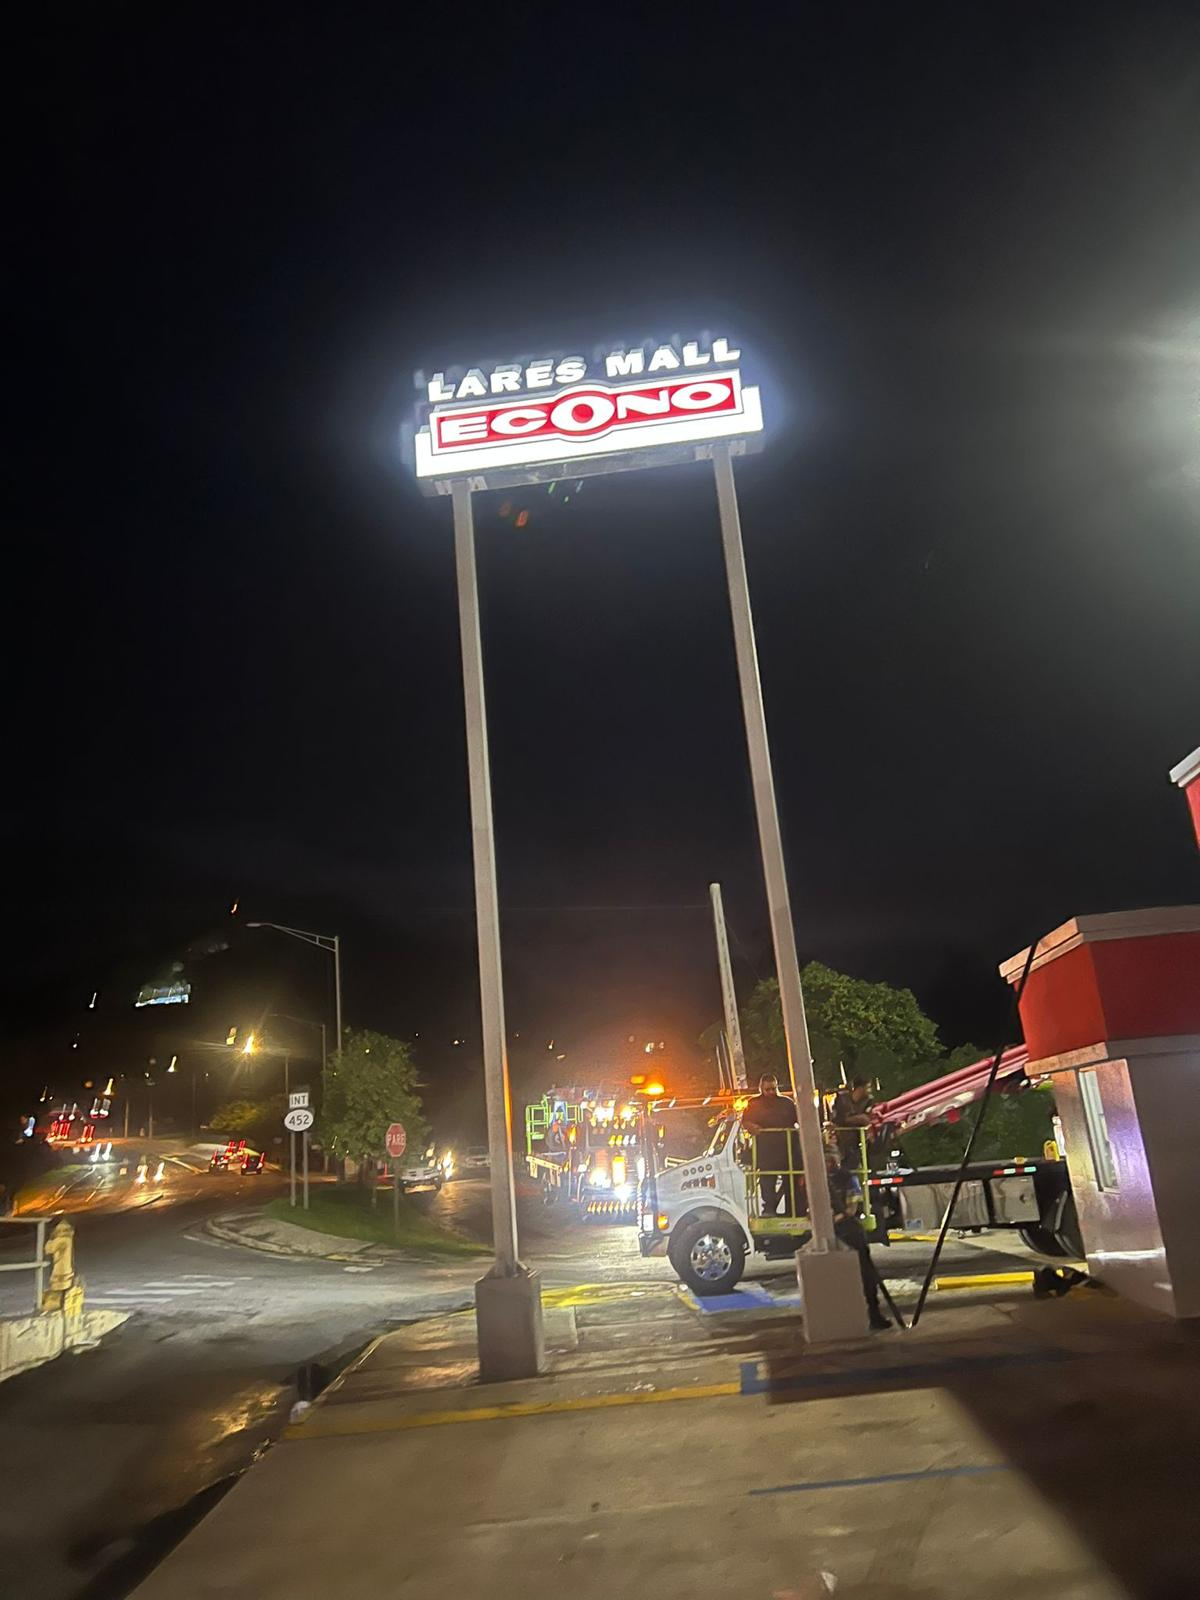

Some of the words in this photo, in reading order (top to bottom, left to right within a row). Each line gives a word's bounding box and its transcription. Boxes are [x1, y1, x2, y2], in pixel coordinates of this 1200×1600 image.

[428, 356, 587, 402] LARES
[606, 338, 741, 378] MALL
[441, 382, 731, 443] ECONO
[291, 1095, 307, 1105] INT
[289, 1115, 309, 1126] 452
[387, 1133, 405, 1146] PARE
